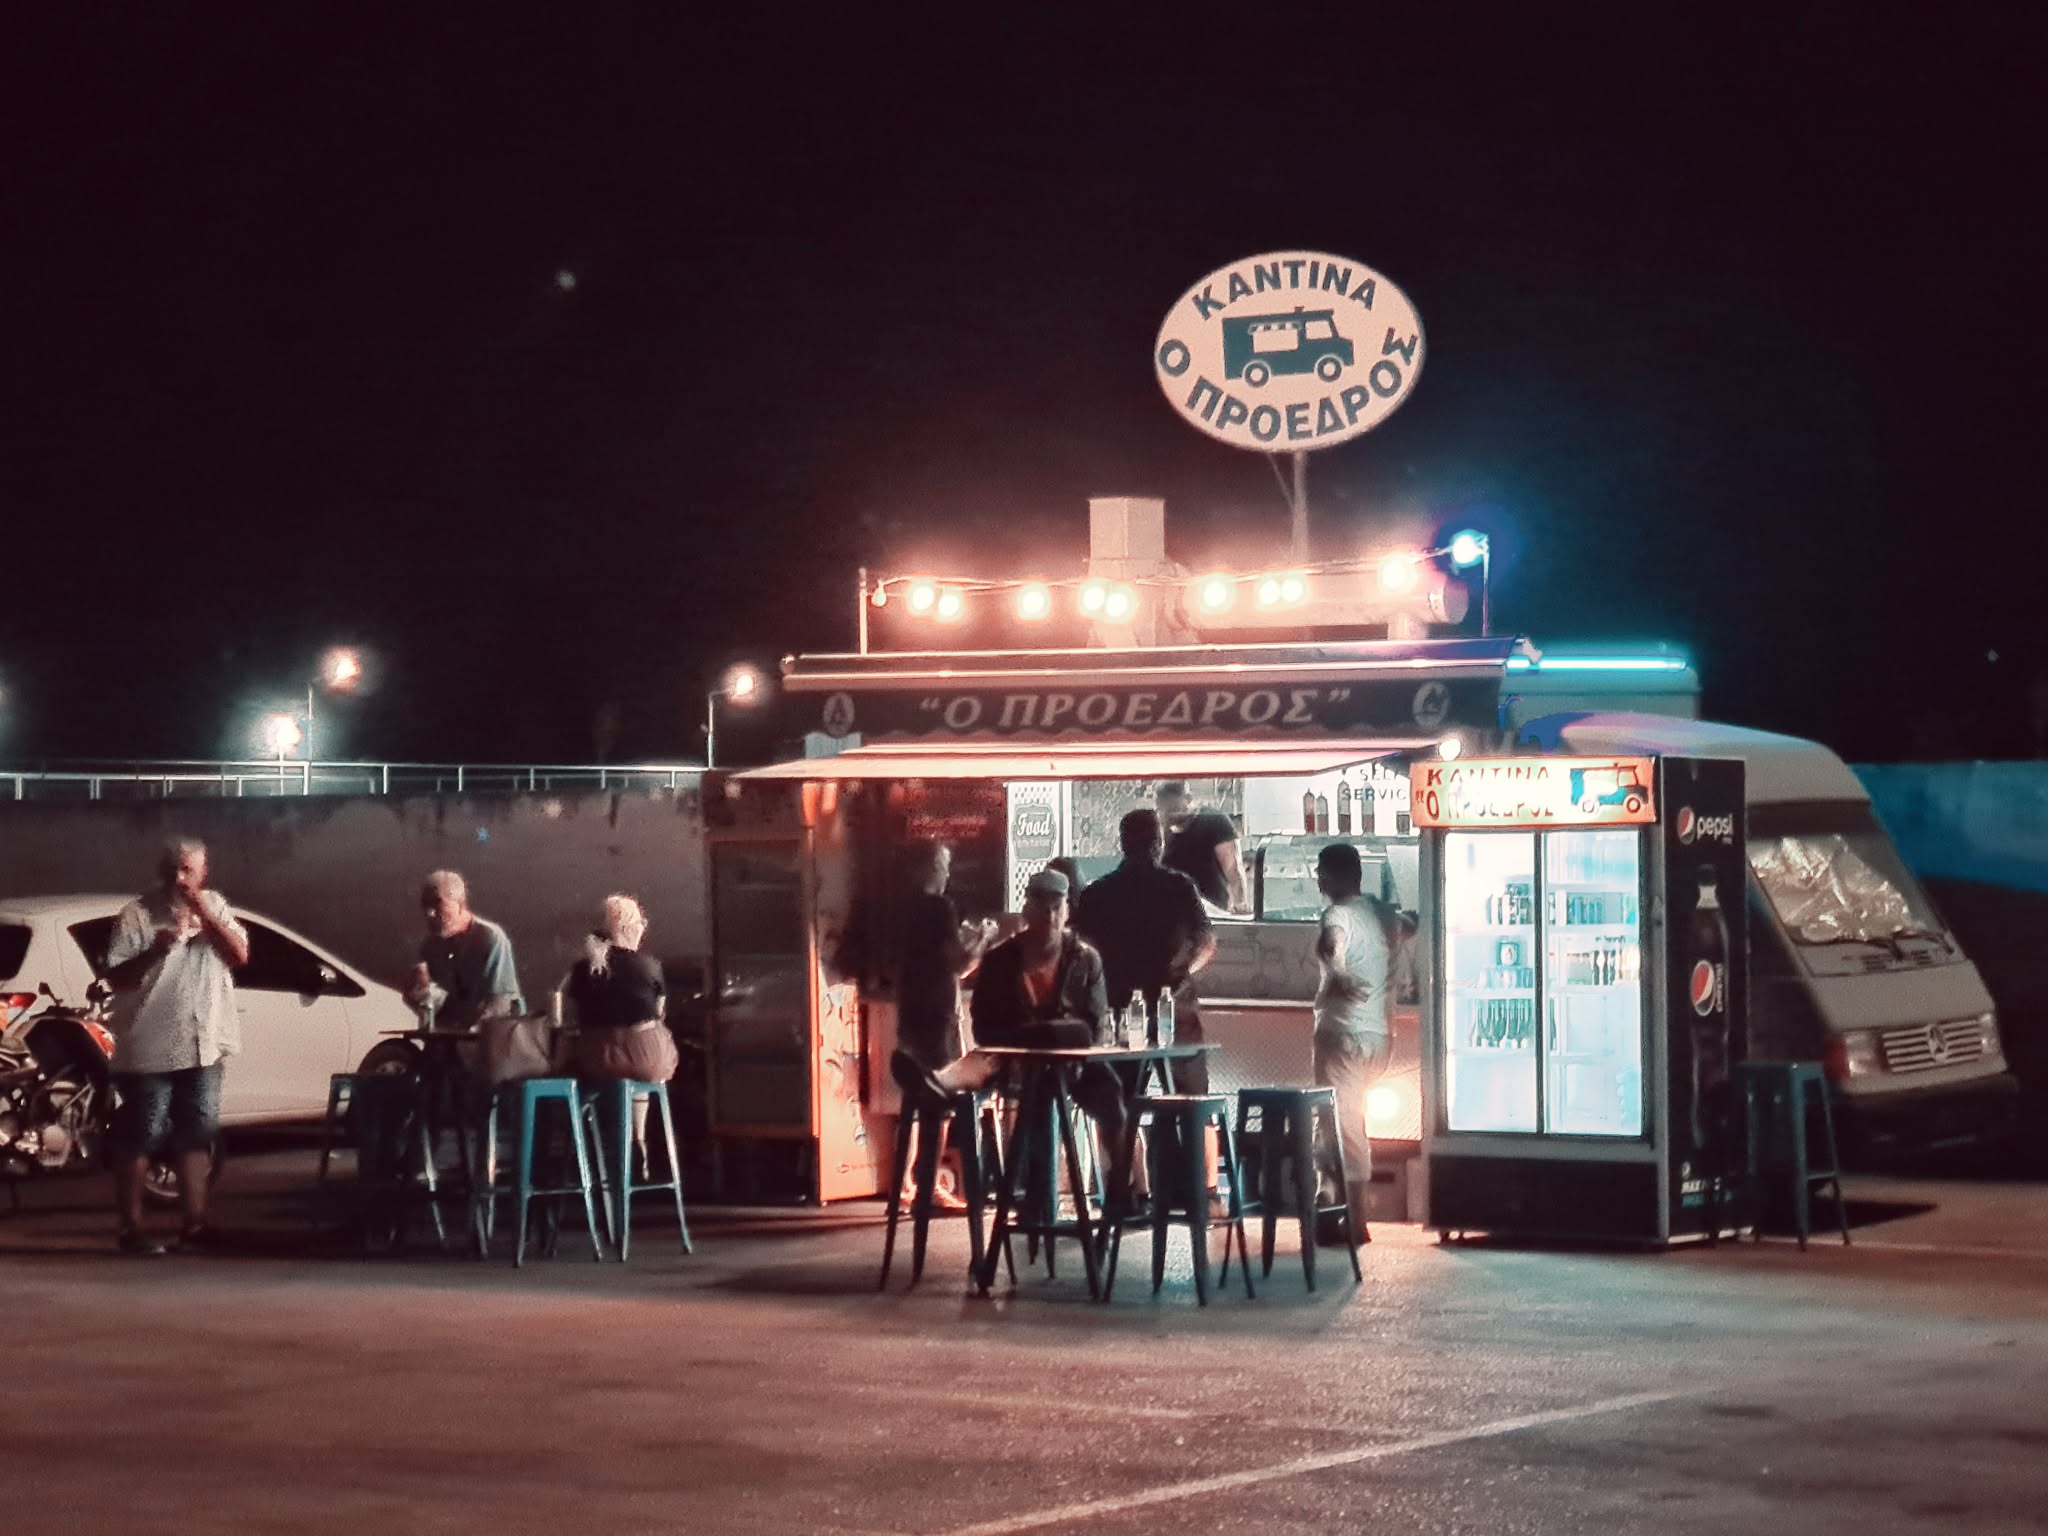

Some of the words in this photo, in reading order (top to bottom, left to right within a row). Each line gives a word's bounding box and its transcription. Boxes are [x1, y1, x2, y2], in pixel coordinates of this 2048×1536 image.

[1191, 260, 1376, 320] ΚΑΝΤΙΝΑ
[1159, 339, 1191, 377] Ο
[1185, 327, 1418, 441] ΠΡΟΕΔΡΟΣ
[1017, 812, 1051, 836] Food
[1697, 813, 1734, 840] pepsi
